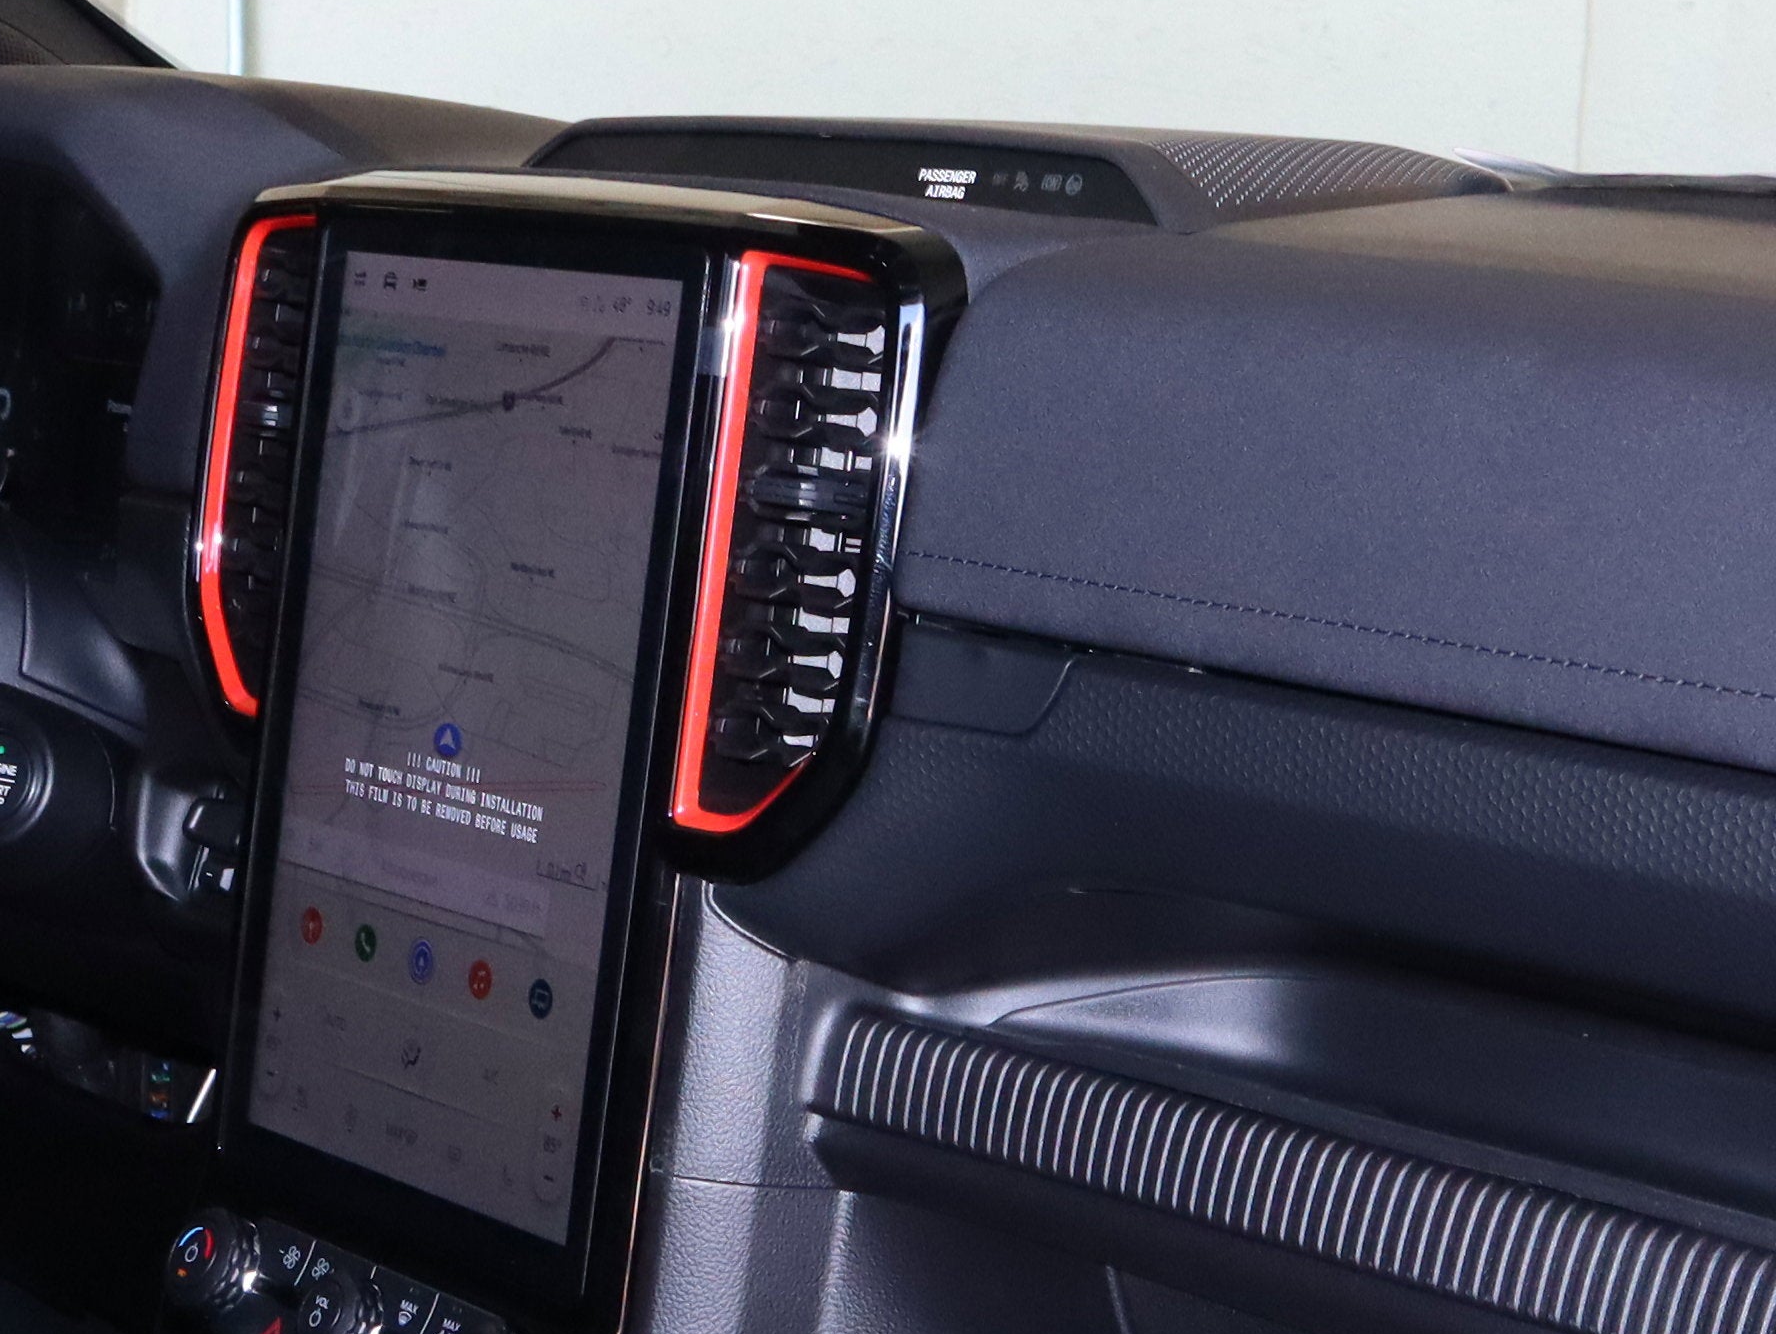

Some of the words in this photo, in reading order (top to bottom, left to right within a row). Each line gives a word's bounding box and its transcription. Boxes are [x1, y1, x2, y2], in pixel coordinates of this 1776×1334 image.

[918, 167, 977, 184] PASSENGER
[924, 184, 966, 200] AIRBAG
[425, 756, 462, 779] CAUTION
[344, 757, 356, 774] DO
[358, 761, 373, 778] NOT
[376, 766, 403, 786] TOUCH
[405, 773, 441, 796] DISPLAY
[444, 783, 477, 805] DURING
[479, 792, 543, 822] INSTALLATION
[345, 779, 365, 798] THIS
[367, 785, 388, 804] FILM
[391, 791, 403, 808] IS
[406, 795, 417, 812] TO
[420, 798, 432, 815] BE
[435, 802, 471, 826] REMOVED
[474, 813, 506, 835] BEFORE
[510, 822, 539, 844] USAGE
[315, 1295, 330, 1311] VOL
[399, 1298, 420, 1316] MAX
[442, 1317, 462, 1334] MAX
